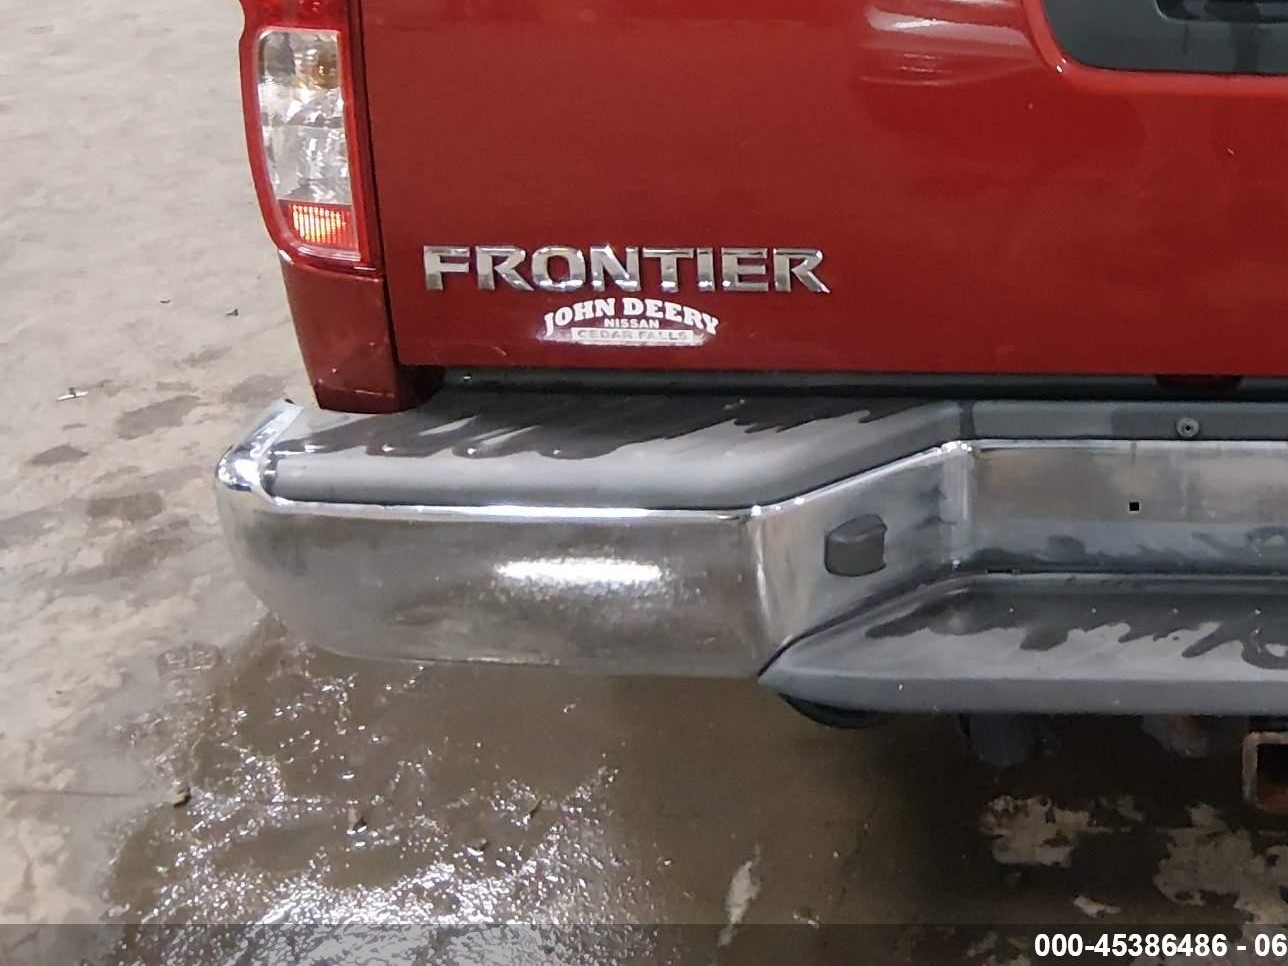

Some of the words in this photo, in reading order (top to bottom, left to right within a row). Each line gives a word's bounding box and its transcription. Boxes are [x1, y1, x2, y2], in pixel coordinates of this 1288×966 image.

[423, 244, 831, 294] FRONTIER
[544, 297, 616, 337] JOHN
[622, 297, 720, 335] DEERY
[603, 318, 660, 329] NISSAN
[576, 328, 634, 340] CEDAR
[638, 330, 688, 341] FALLS
